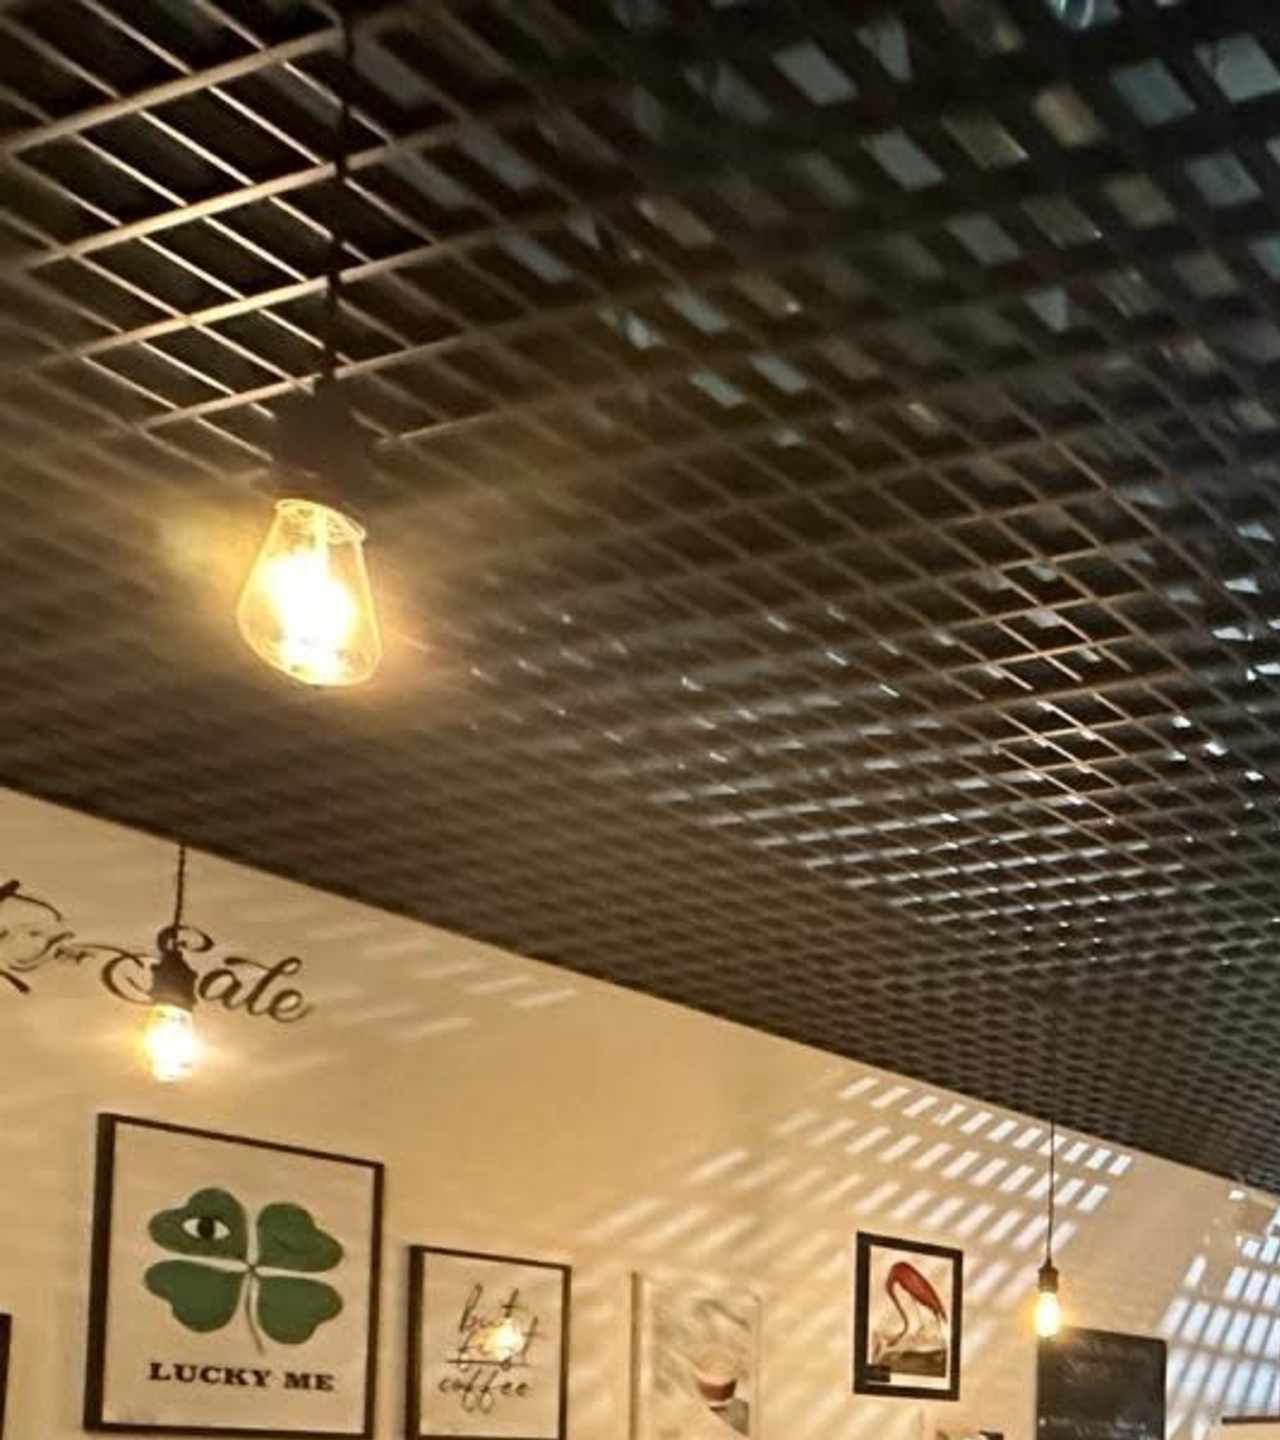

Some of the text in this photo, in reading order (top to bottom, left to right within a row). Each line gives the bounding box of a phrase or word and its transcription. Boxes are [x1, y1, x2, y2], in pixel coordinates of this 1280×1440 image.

[148, 1362, 335, 1392] LUCKY ME
[437, 1367, 532, 1414] coffee
